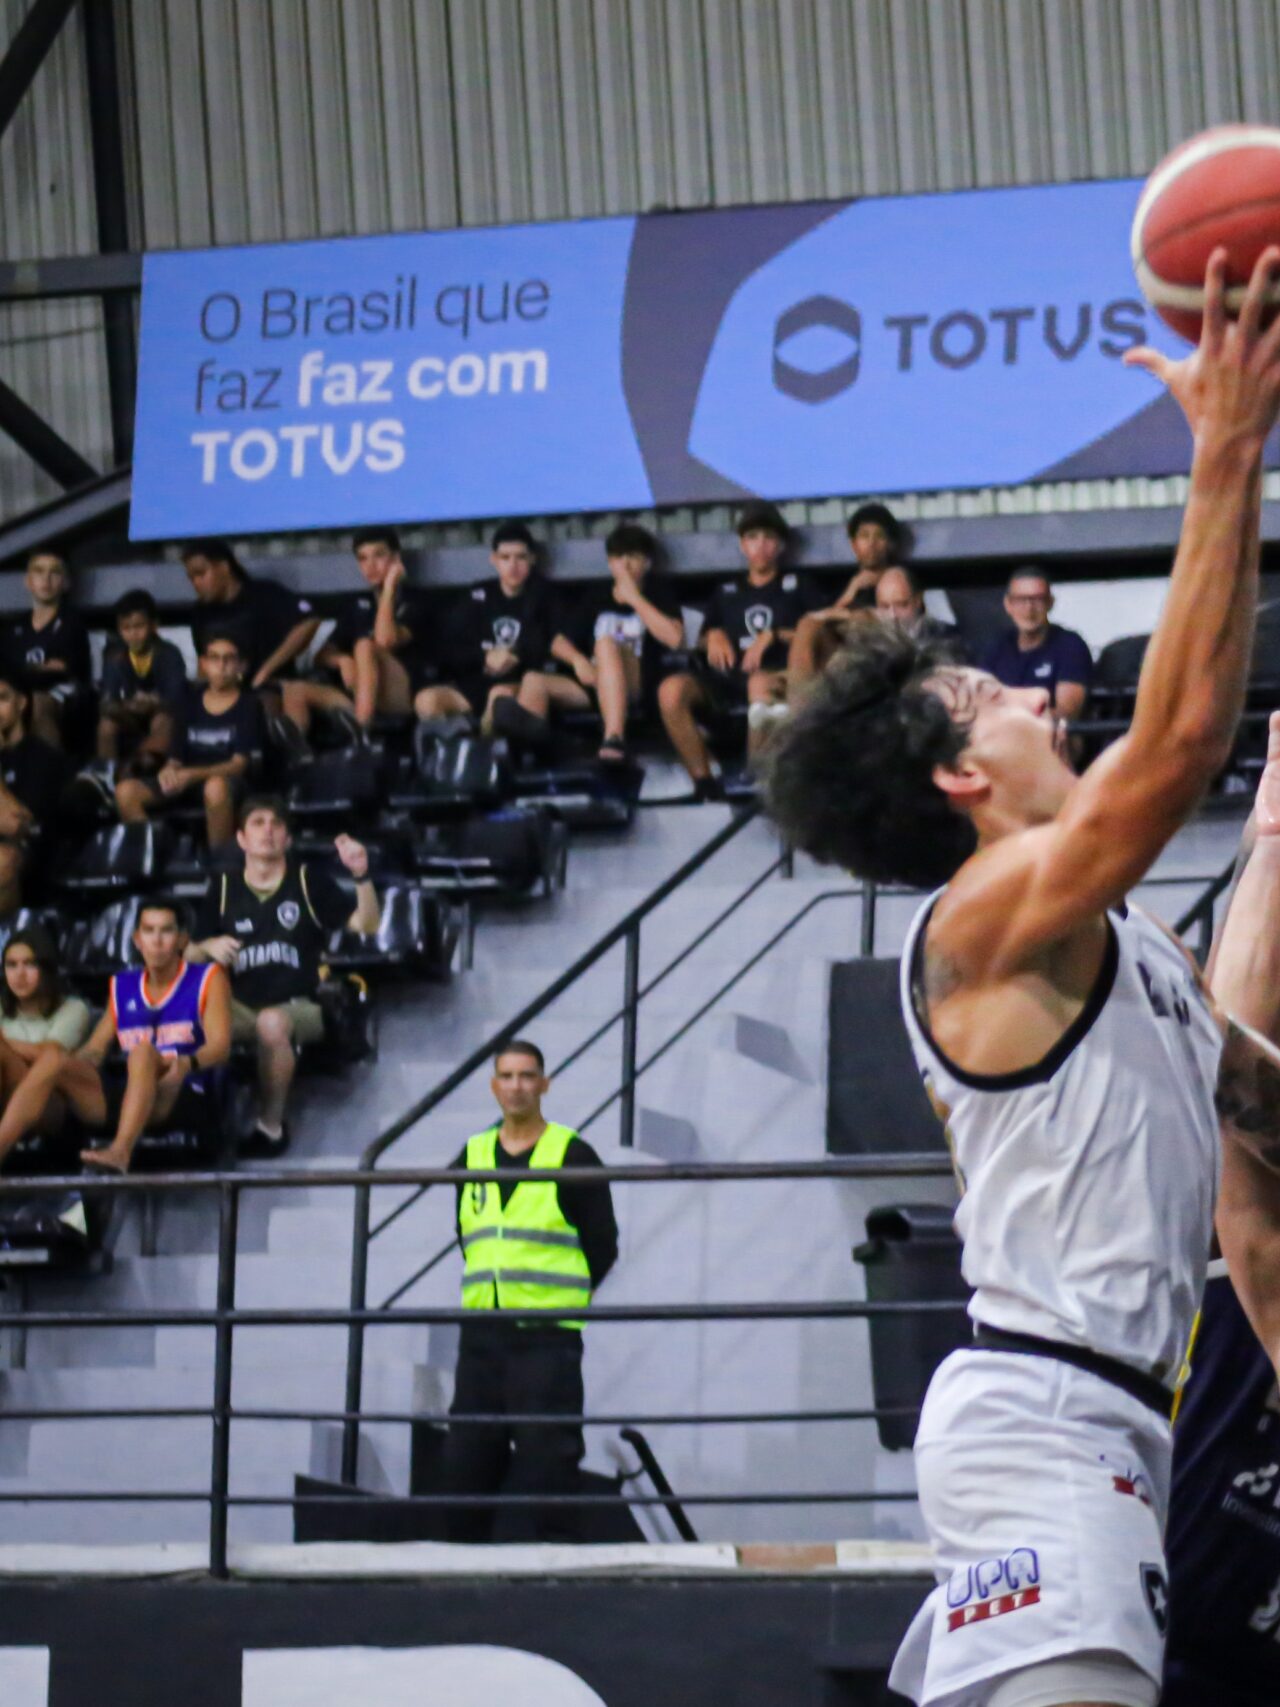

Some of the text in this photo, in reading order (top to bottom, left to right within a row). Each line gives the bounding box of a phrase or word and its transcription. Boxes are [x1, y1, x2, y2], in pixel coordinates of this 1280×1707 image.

[200, 276, 550, 343] O Brasil que
[884, 299, 1148, 371] TOTVS
[194, 348, 549, 414] faz faz com
[190, 420, 405, 485] TOTVS
[963, 1593, 1024, 1623] PET
